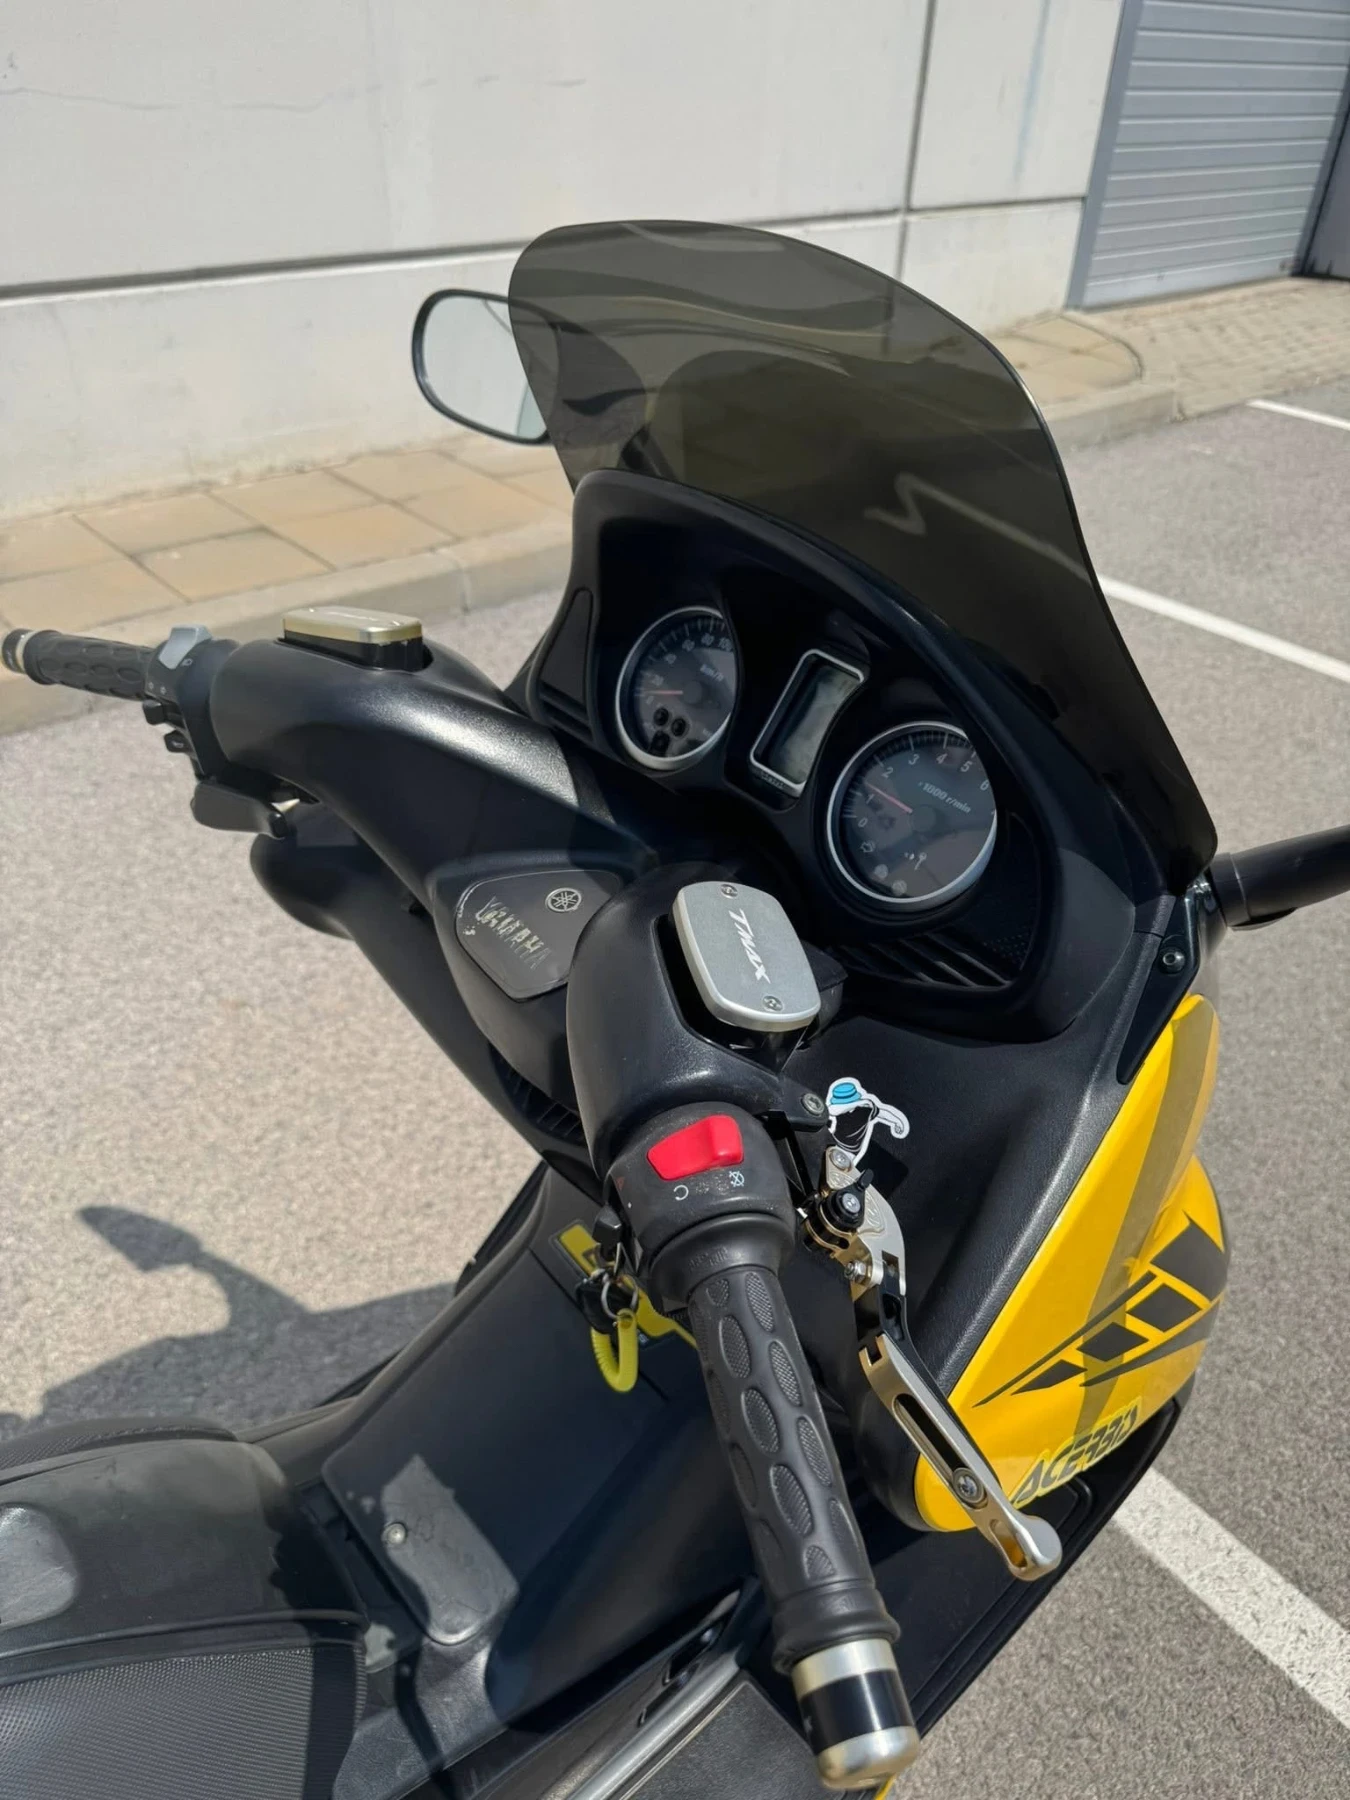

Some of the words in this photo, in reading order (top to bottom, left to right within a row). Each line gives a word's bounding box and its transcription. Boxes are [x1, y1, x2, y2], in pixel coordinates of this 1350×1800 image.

[908, 753, 920, 765] 3
[935, 753, 948, 765] 4
[881, 766, 894, 779] 2
[960, 760, 973, 773] 5
[980, 779, 990, 791] 6
[865, 793, 875, 805] 1
[945, 797, 972, 814] r/min
[857, 816, 868, 828] 0
[728, 908, 772, 984] TMAX
